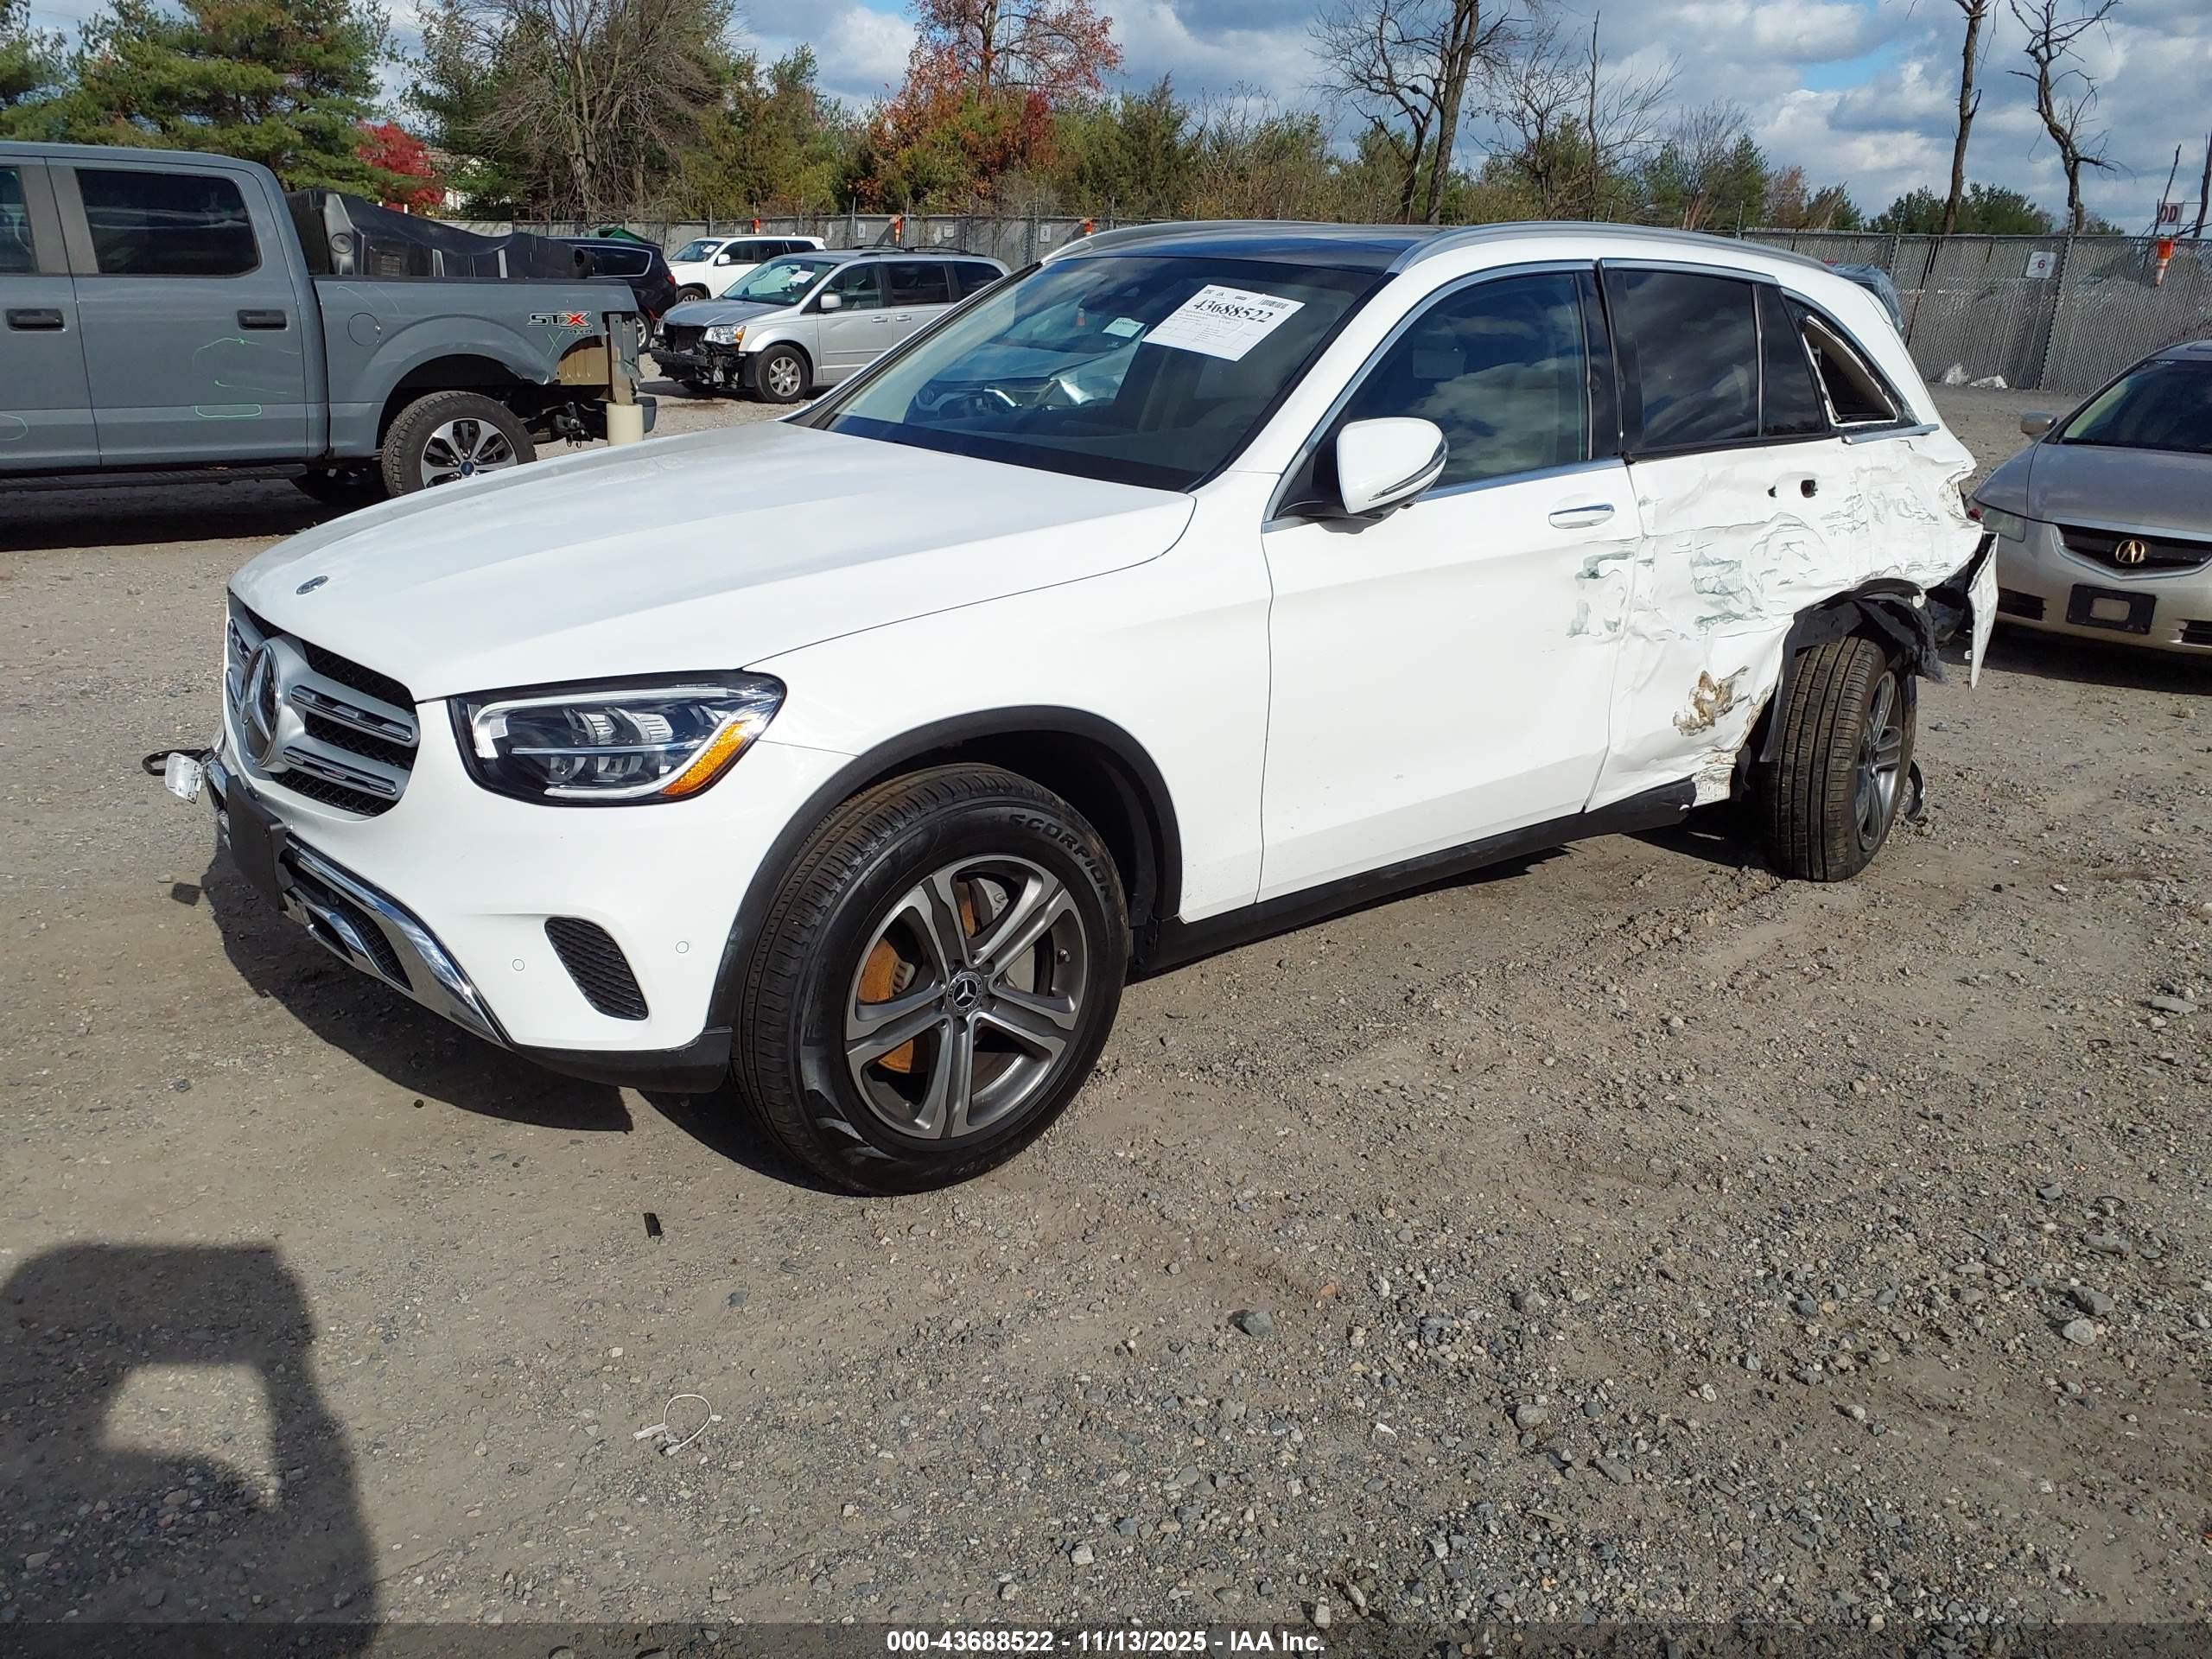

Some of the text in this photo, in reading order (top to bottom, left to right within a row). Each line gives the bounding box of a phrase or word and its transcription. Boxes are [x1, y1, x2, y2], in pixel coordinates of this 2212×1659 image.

[2037, 259, 2046, 269] 6
[527, 311, 593, 327] STX
[1193, 299, 1274, 323] 43688522
[1008, 813, 1113, 903] SCORPION
